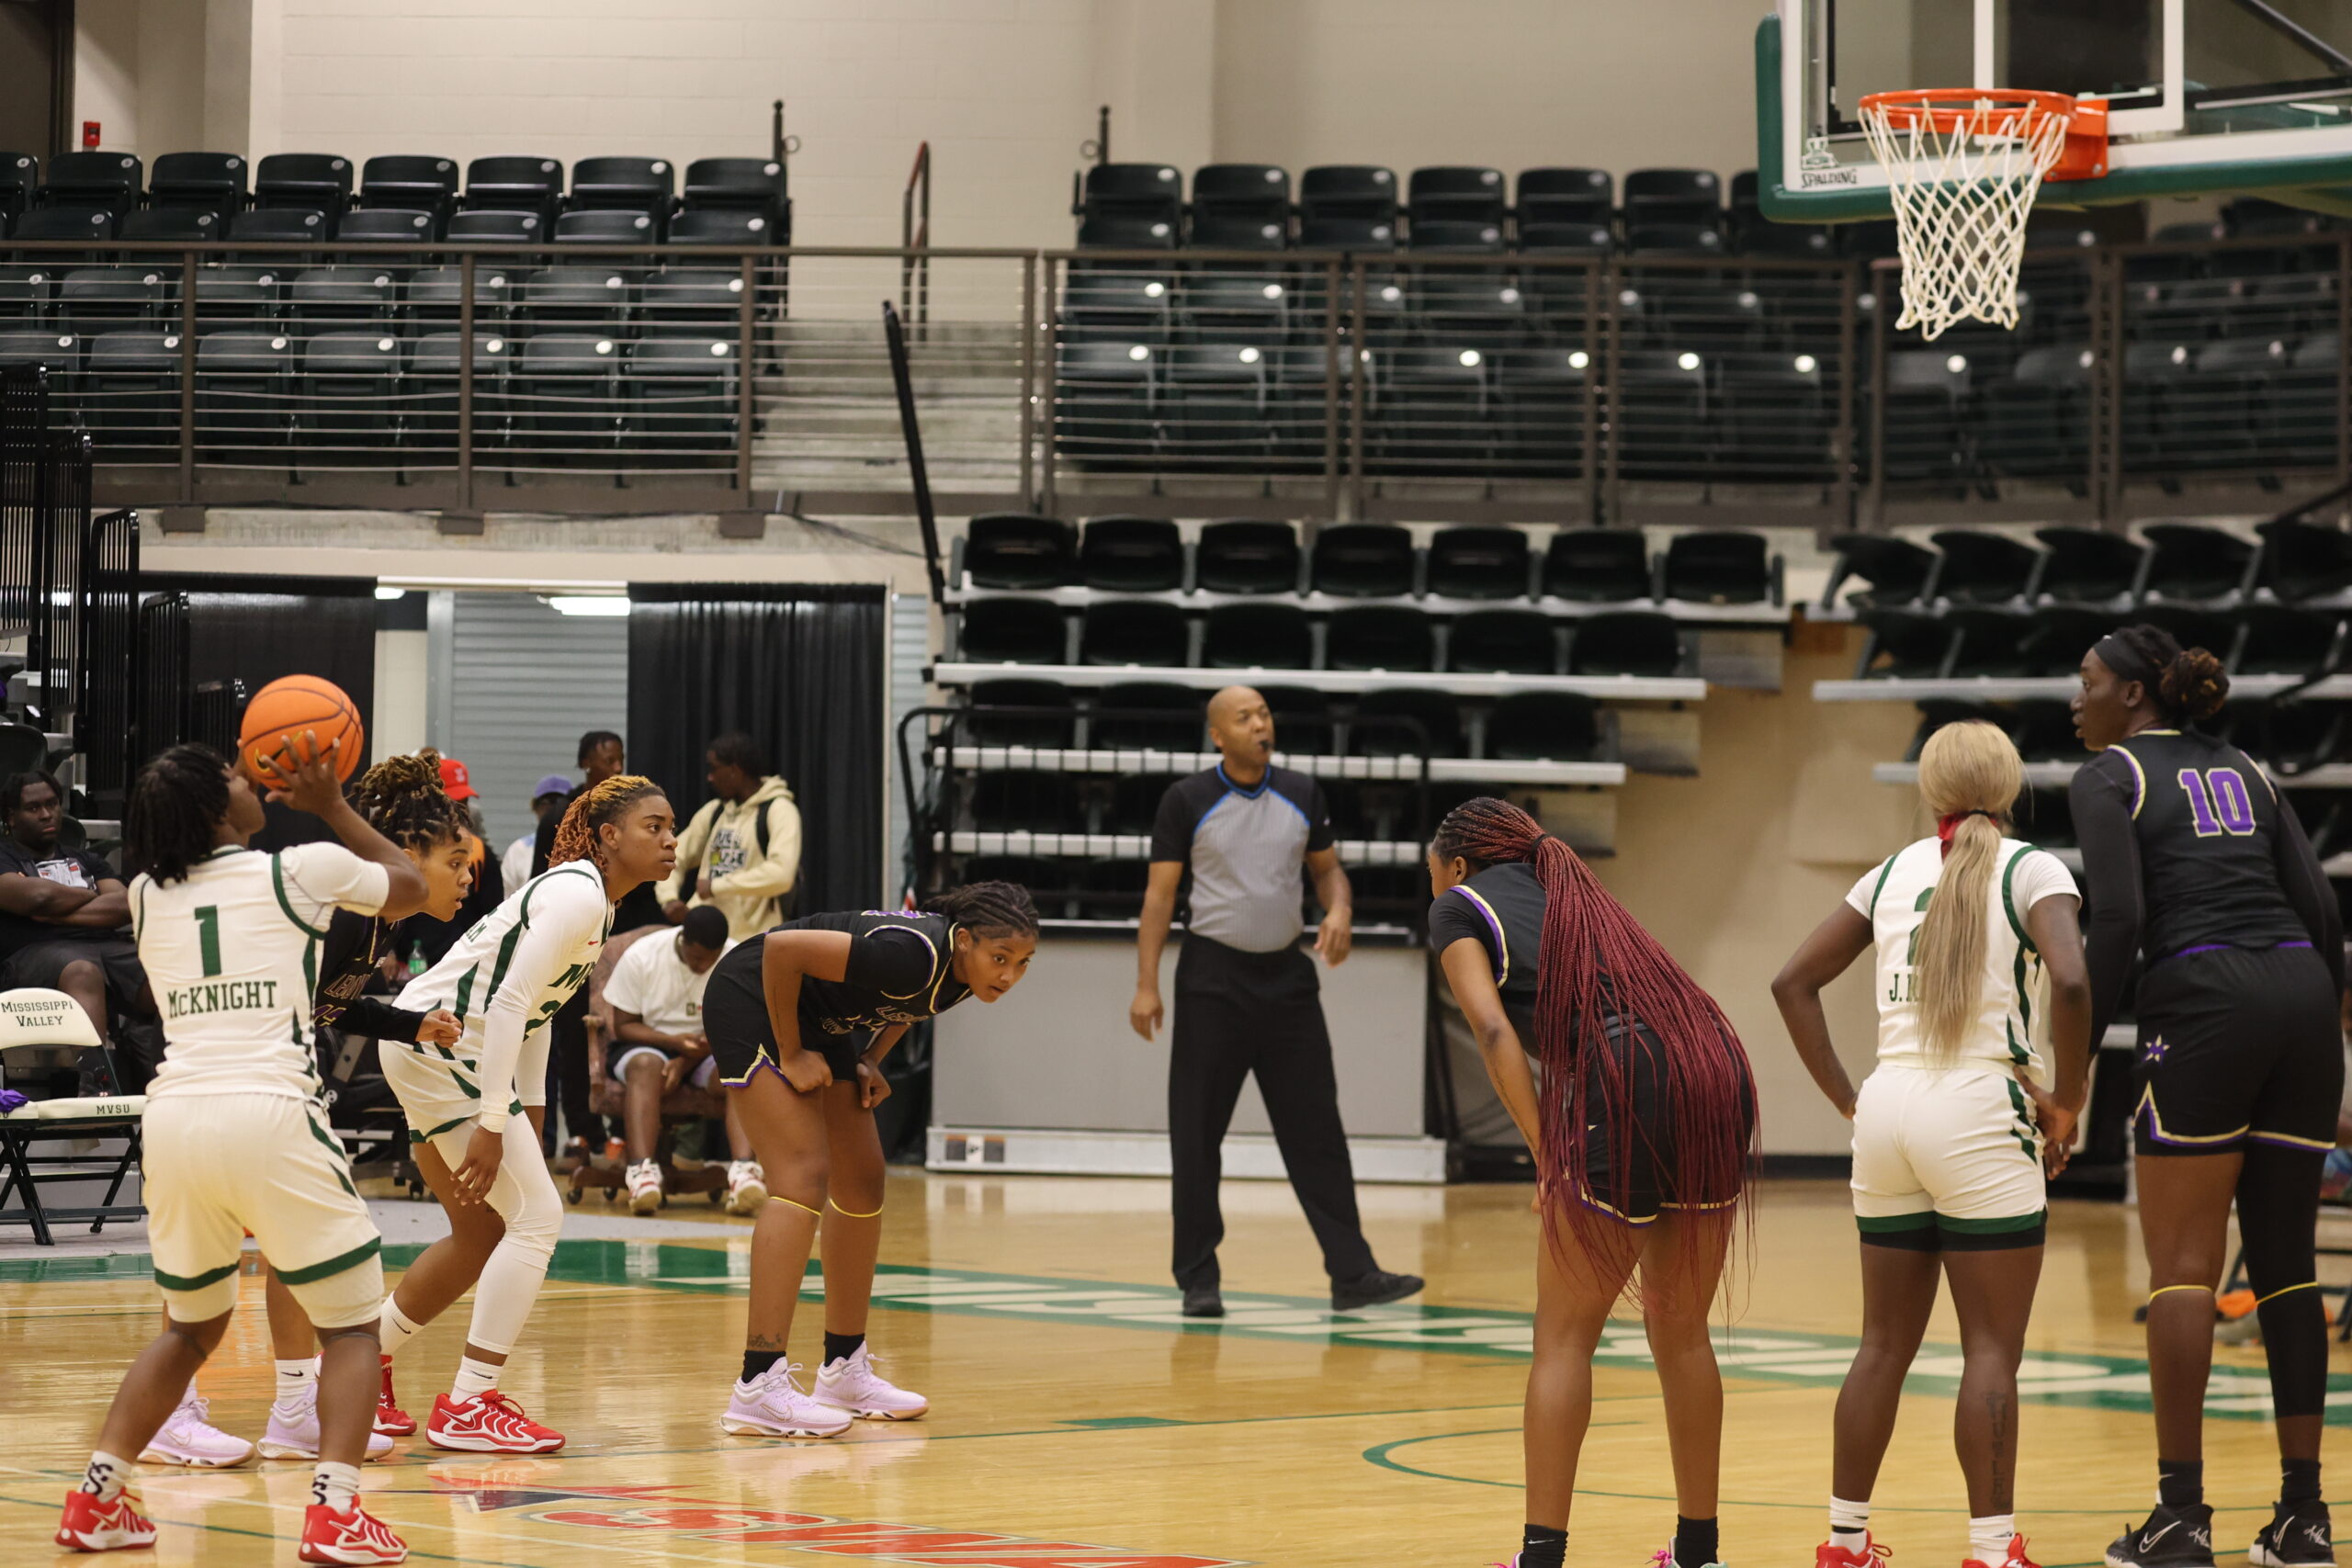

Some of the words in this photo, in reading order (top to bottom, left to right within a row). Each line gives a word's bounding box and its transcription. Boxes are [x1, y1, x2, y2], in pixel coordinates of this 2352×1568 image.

[1802, 169, 1857, 188] SPALDING
[2177, 767, 2256, 838] 10
[195, 905, 221, 977] 1
[168, 981, 277, 1019] McKNIGHT
[16, 1015, 63, 1027] VALLEY
[96, 1104, 130, 1114] MVSU
